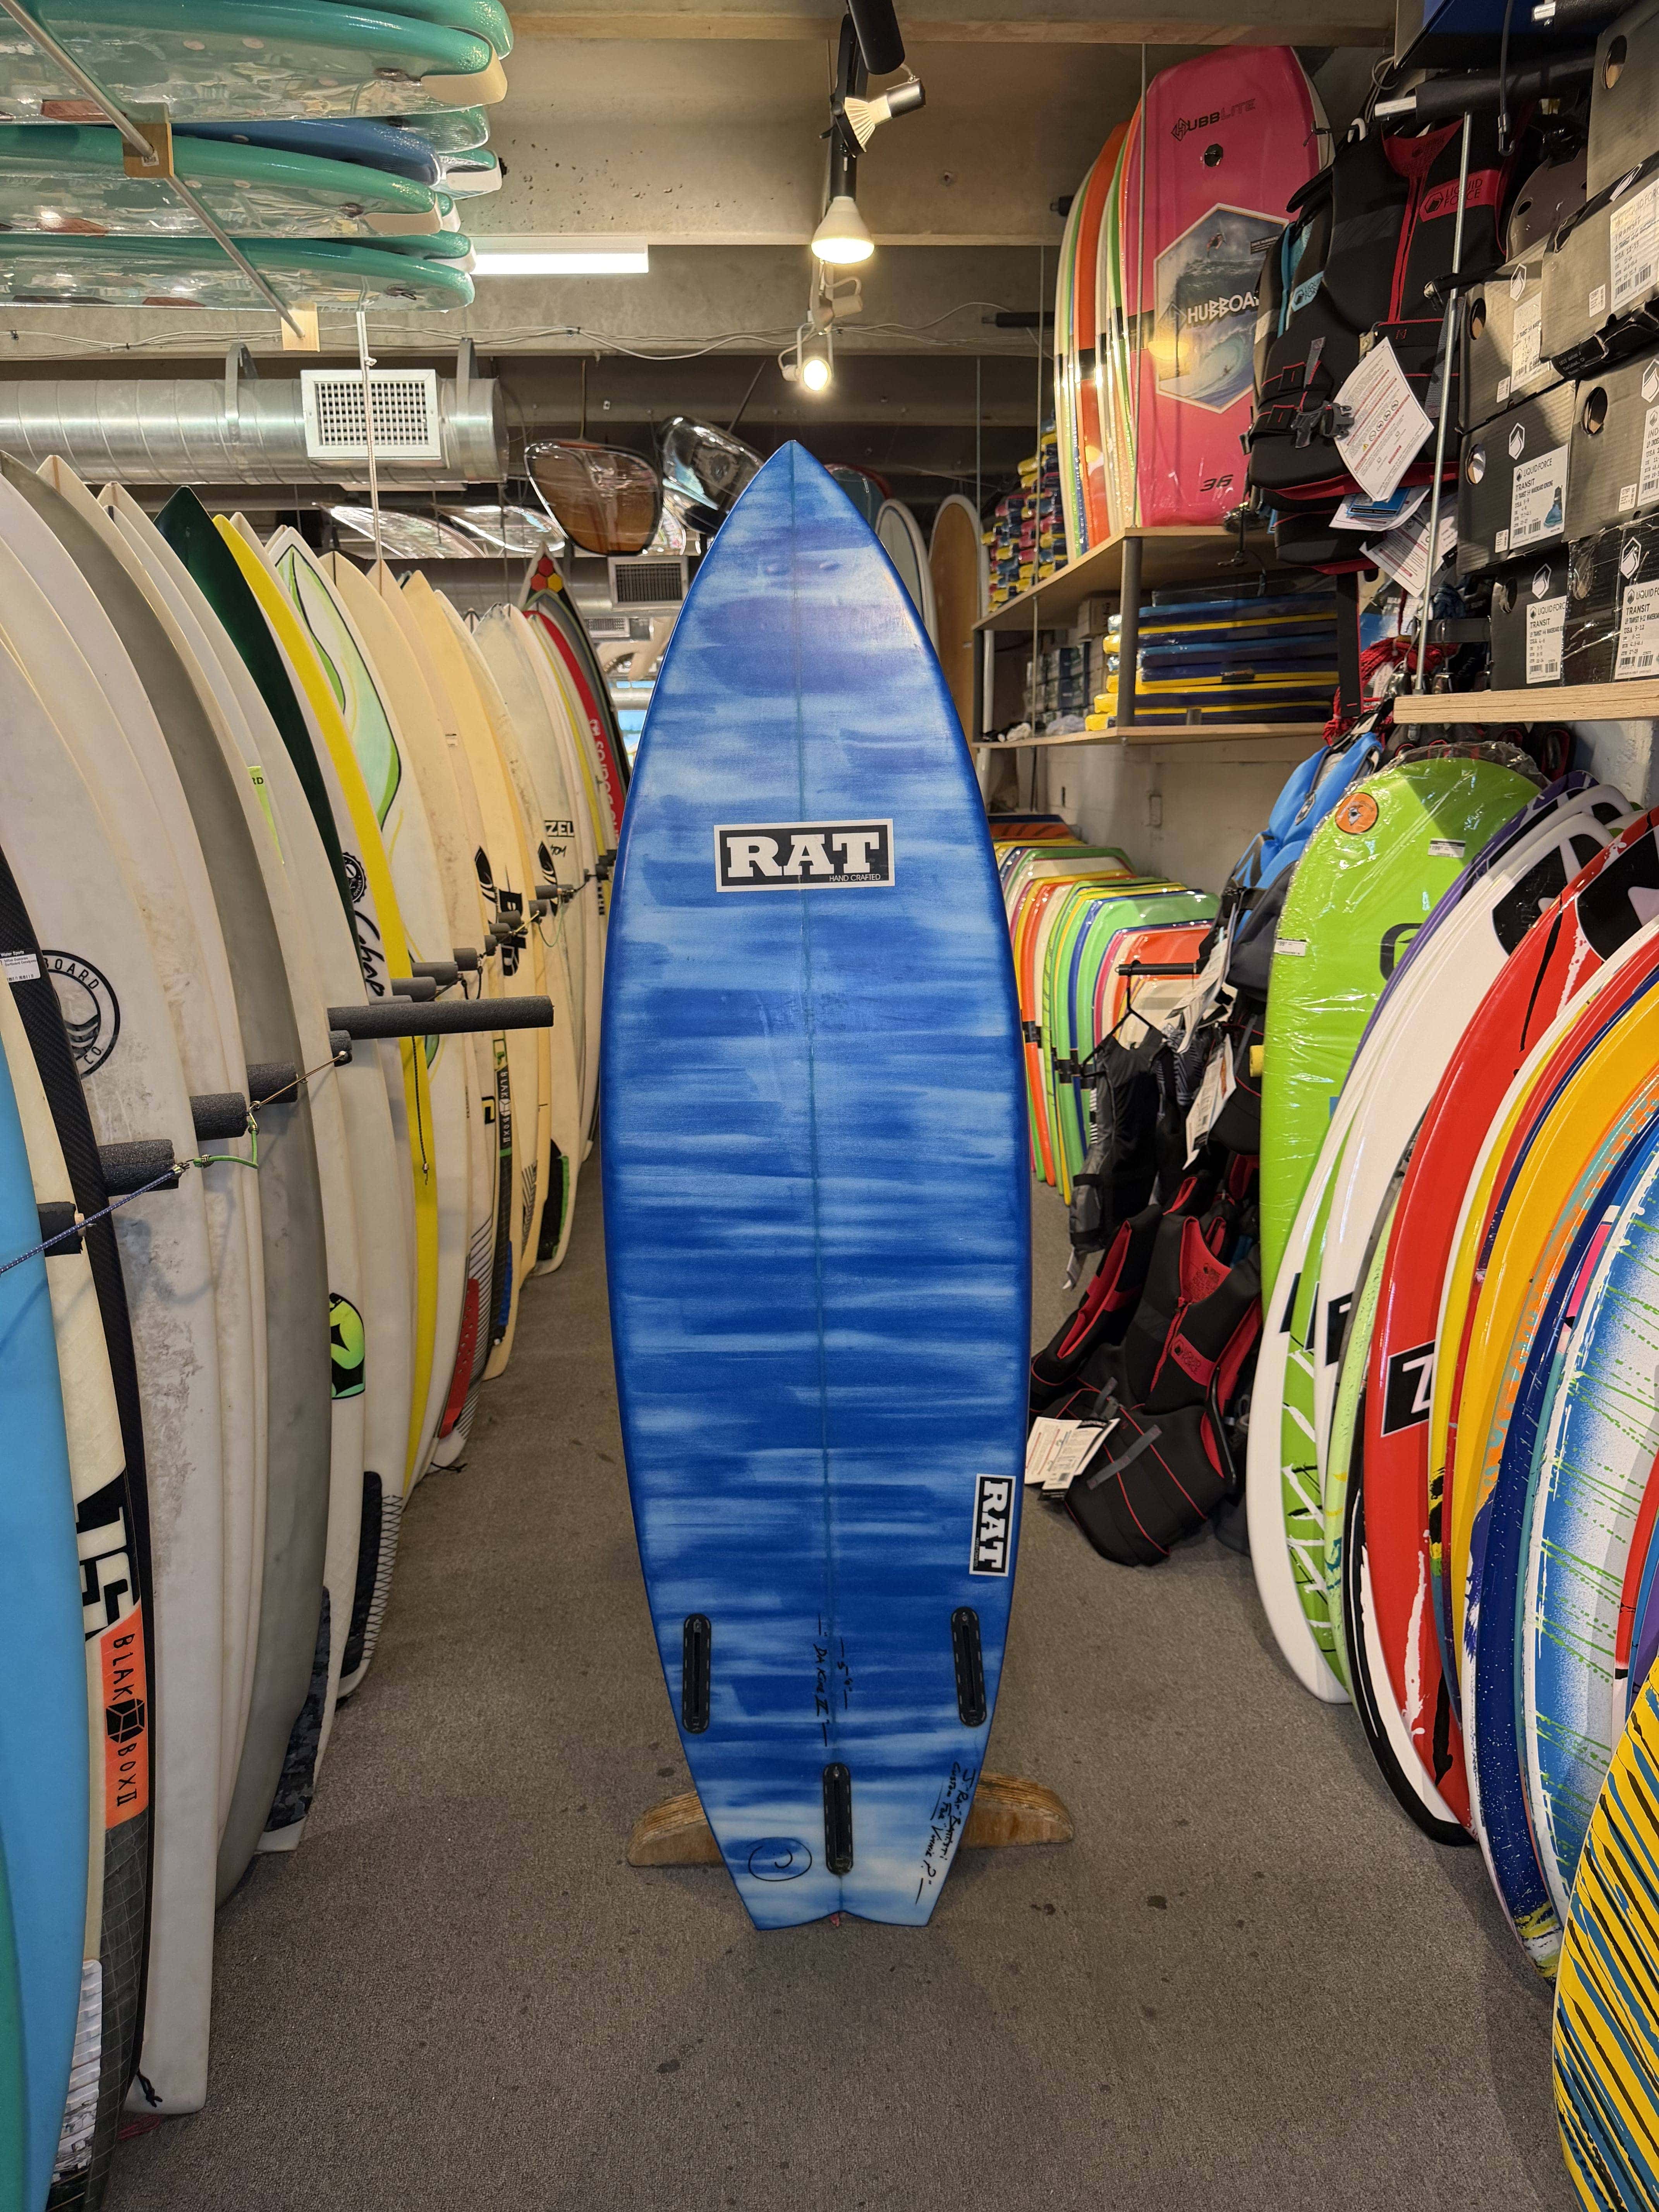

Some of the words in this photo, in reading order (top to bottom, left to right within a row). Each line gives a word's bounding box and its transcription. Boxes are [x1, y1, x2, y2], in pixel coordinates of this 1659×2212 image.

[1187, 292, 1259, 324] HUBBOA
[1200, 474, 1233, 492] 36
[1516, 478, 1535, 492] TRANSIT
[1636, 588, 1654, 599] LIQUID
[1626, 603, 1650, 615] TRANSIT
[1530, 618, 1550, 629] TRANSIT
[726, 832, 879, 878] RAT
[978, 1480, 1009, 1568] RAT
[113, 1633, 136, 1701] BLAK
